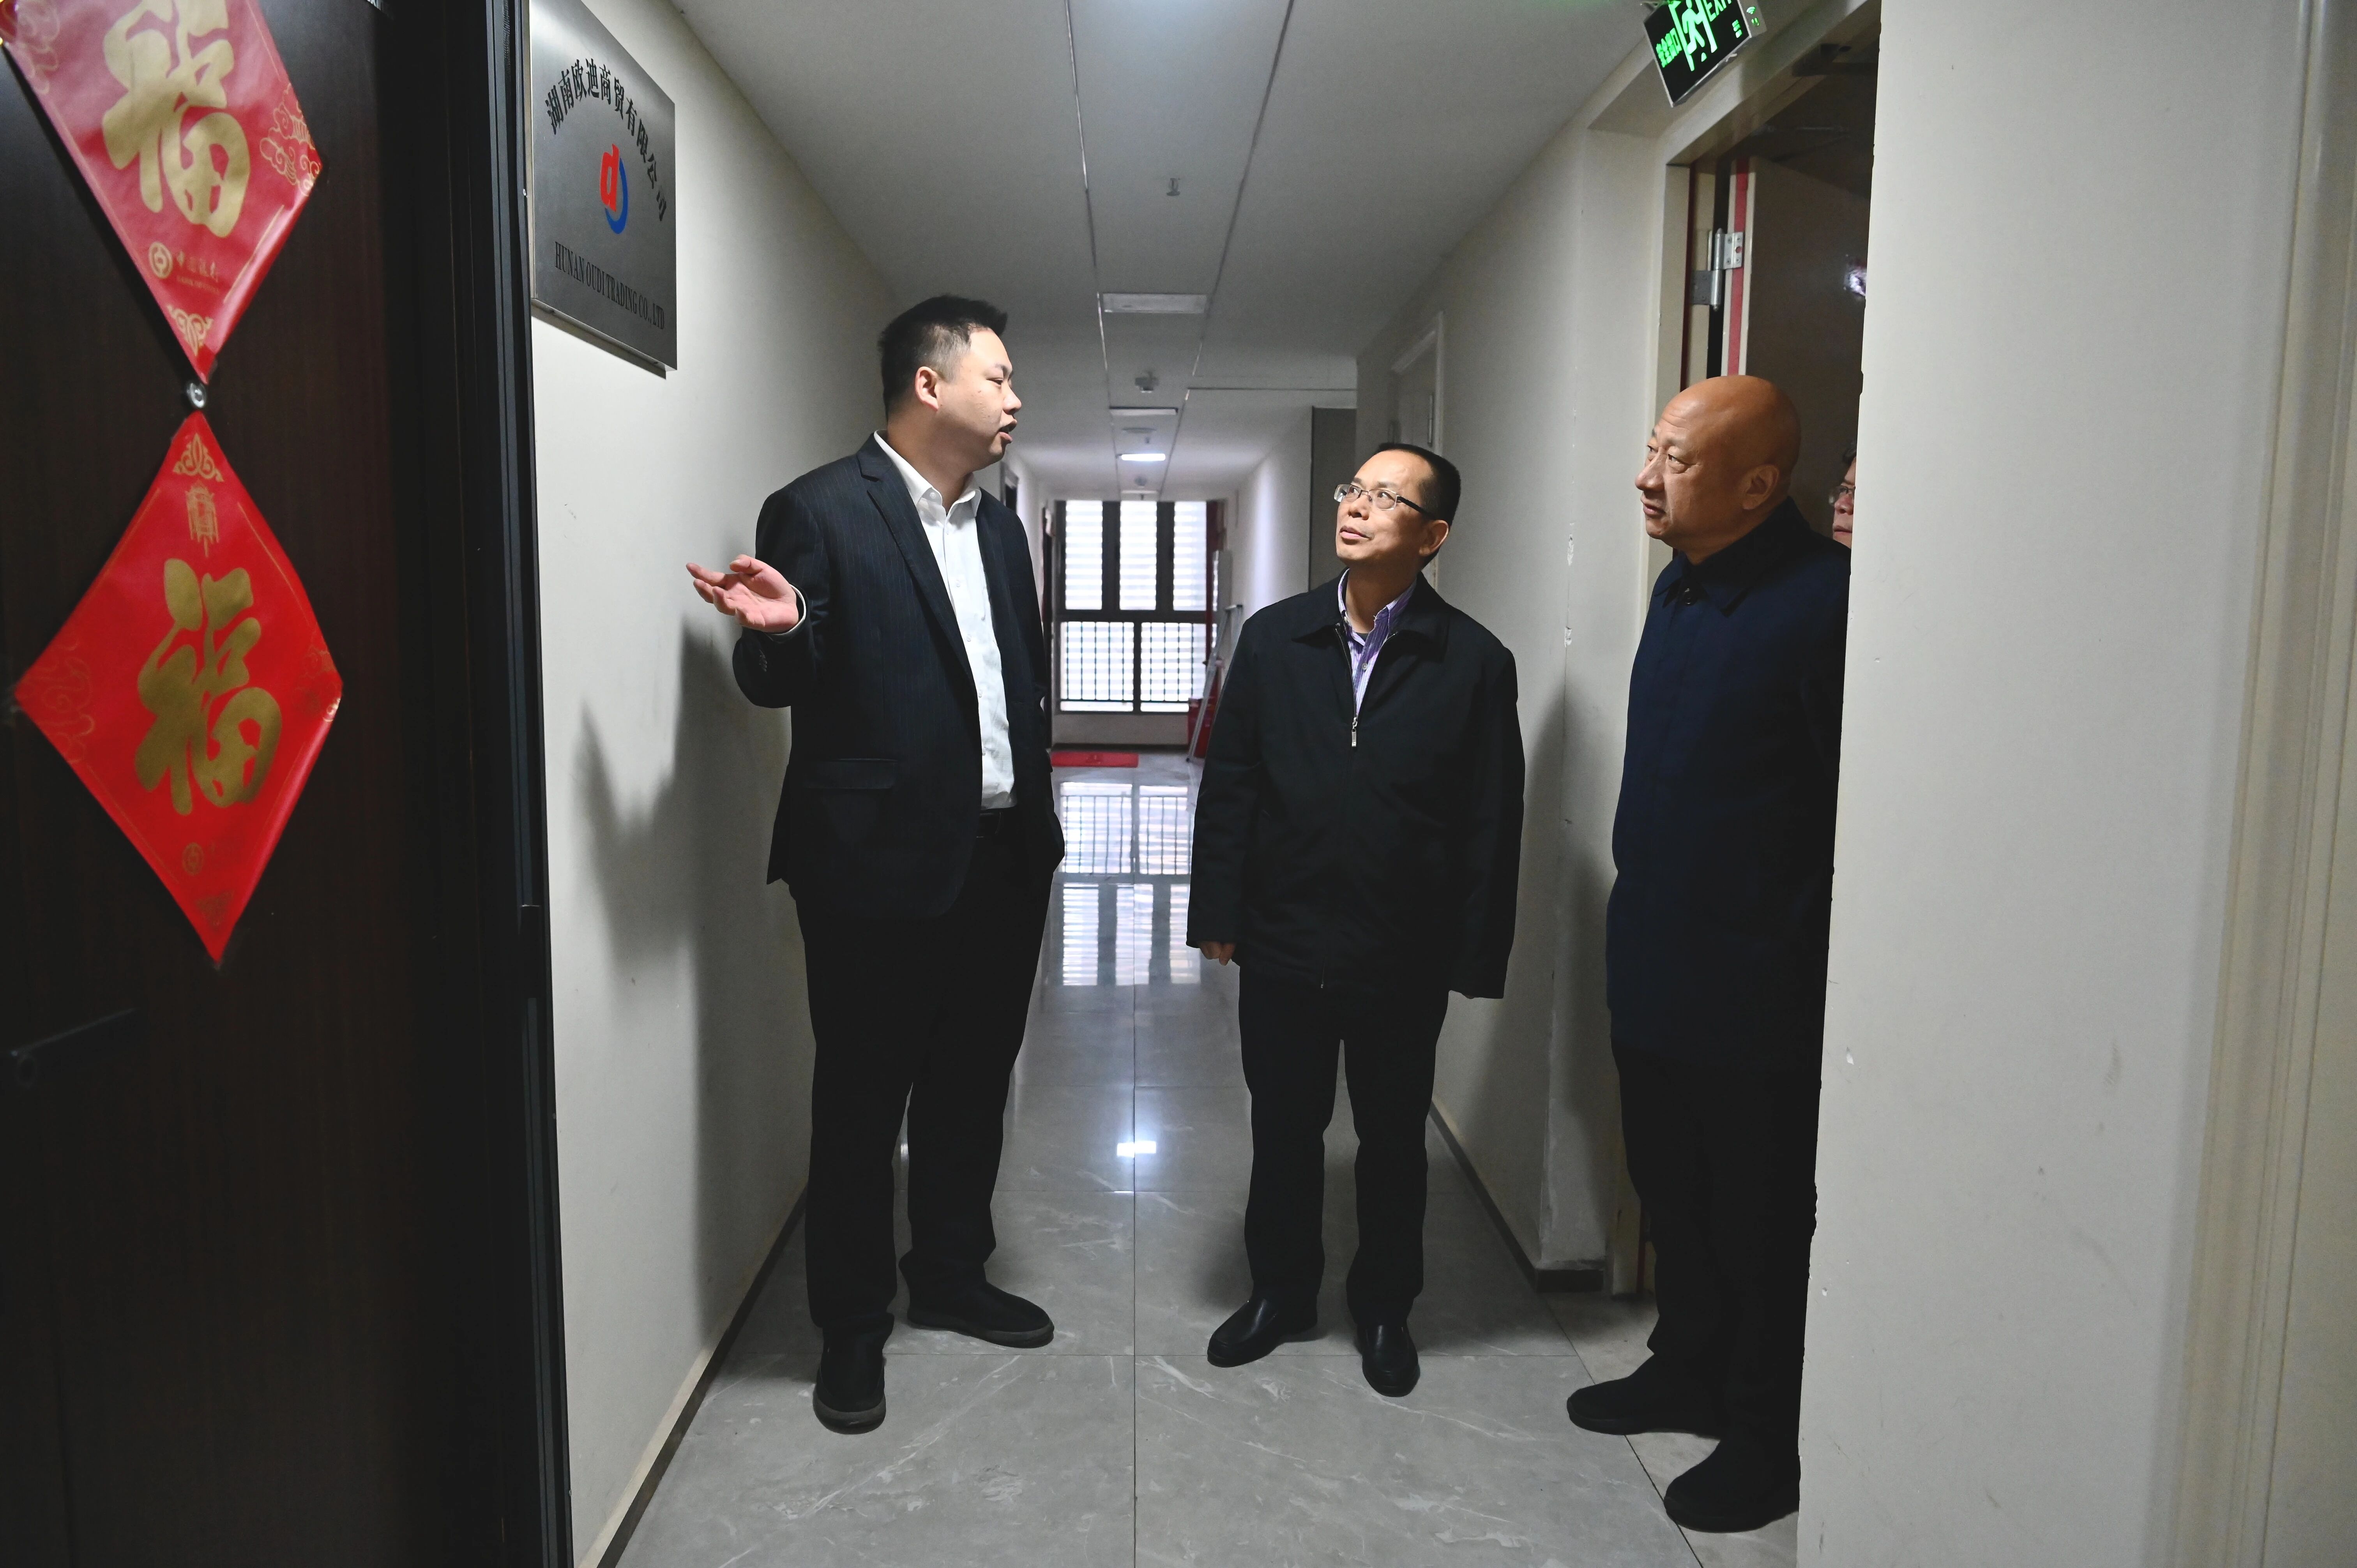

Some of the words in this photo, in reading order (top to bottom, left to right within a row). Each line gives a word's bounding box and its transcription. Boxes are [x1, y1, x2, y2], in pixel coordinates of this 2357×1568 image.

[1703, 0, 1732, 22] EX
[545, 58, 667, 222] 湖南欧迪商贸有限公司
[555, 241, 584, 284] HUNAN
[586, 261, 605, 296] OUDI
[606, 273, 637, 314] TRADING
[134, 558, 282, 815] 福
